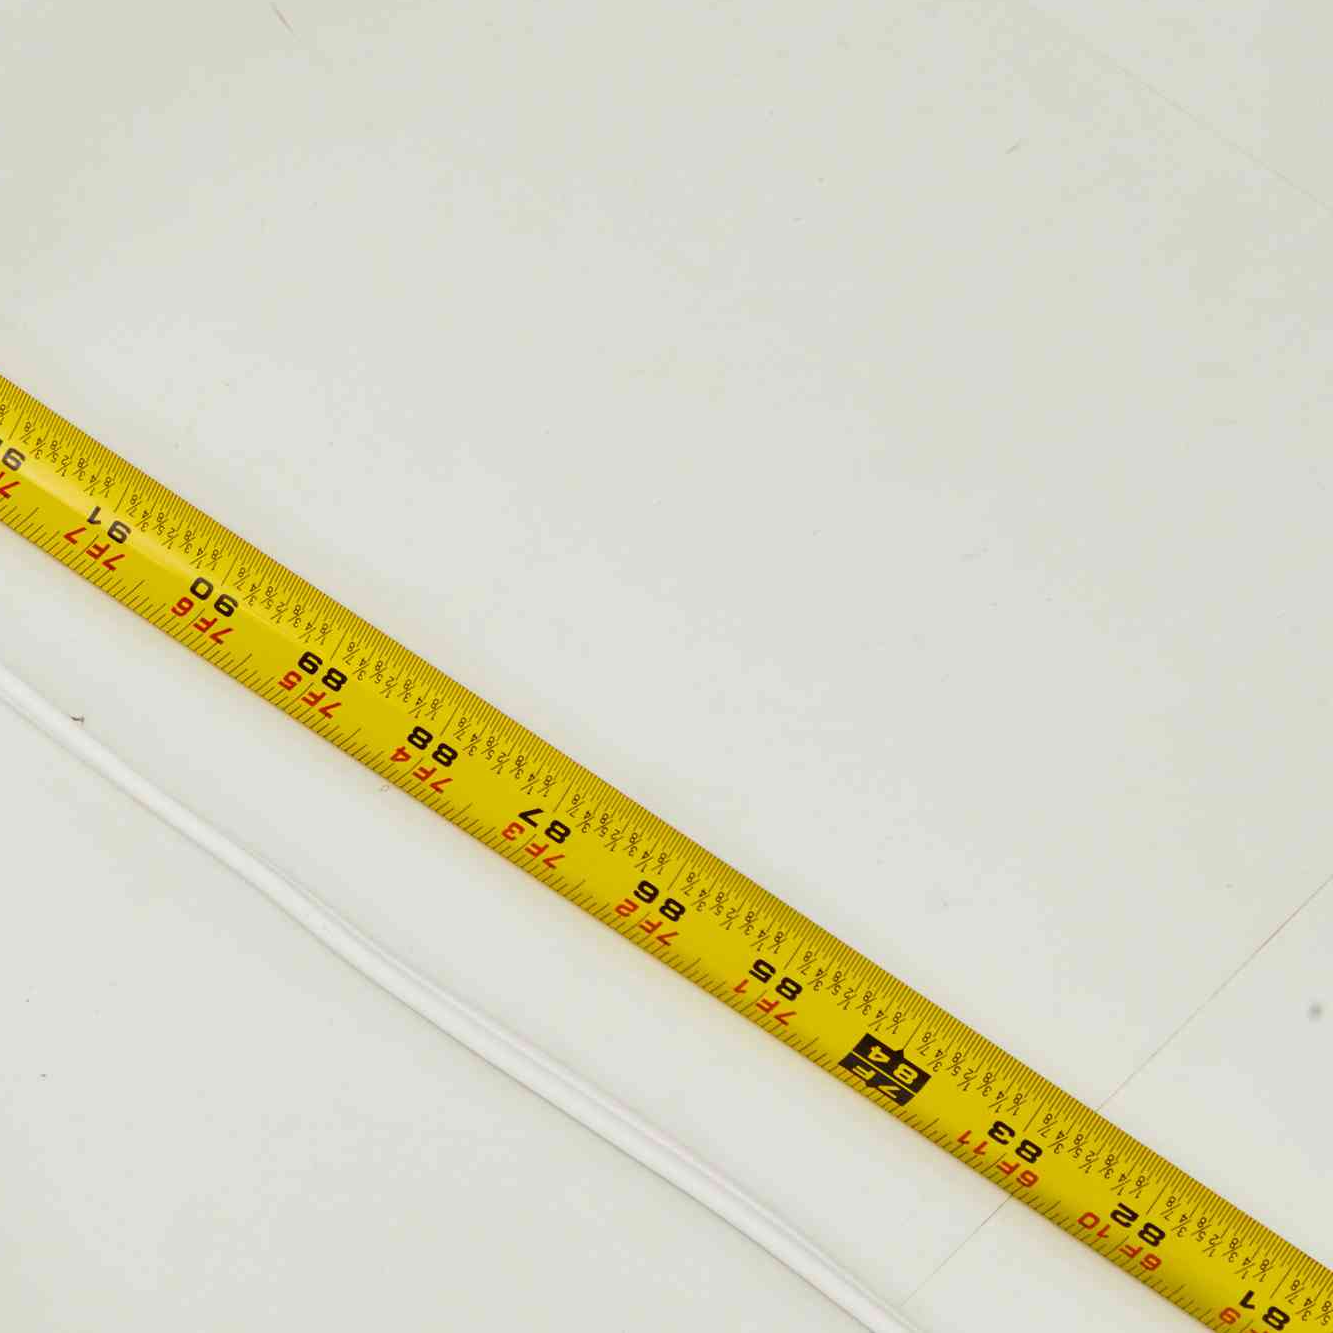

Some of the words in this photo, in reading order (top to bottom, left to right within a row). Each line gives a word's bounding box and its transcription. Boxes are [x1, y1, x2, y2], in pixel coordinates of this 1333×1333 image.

[63, 525, 85, 544] 7
[86, 506, 130, 543] 91
[169, 596, 194, 618] 6
[189, 577, 237, 616] 90
[277, 666, 302, 690] 5
[297, 651, 347, 691] 89
[389, 745, 410, 762] 4
[407, 726, 458, 766] 88
[501, 821, 525, 841] 3
[518, 808, 570, 843] 87
[613, 898, 639, 918] 2
[633, 880, 685, 921] 86
[732, 977, 749, 995] 1
[748, 959, 802, 1000] 85
[868, 1046, 917, 1083] 84
[956, 1129, 988, 1155] 11
[987, 1120, 1042, 1163] 83
[1076, 1212, 1109, 1238] 10
[1110, 1202, 1165, 1246] 82
[1220, 1306, 1240, 1323] 9
[1239, 1290, 1290, 1330] 81
